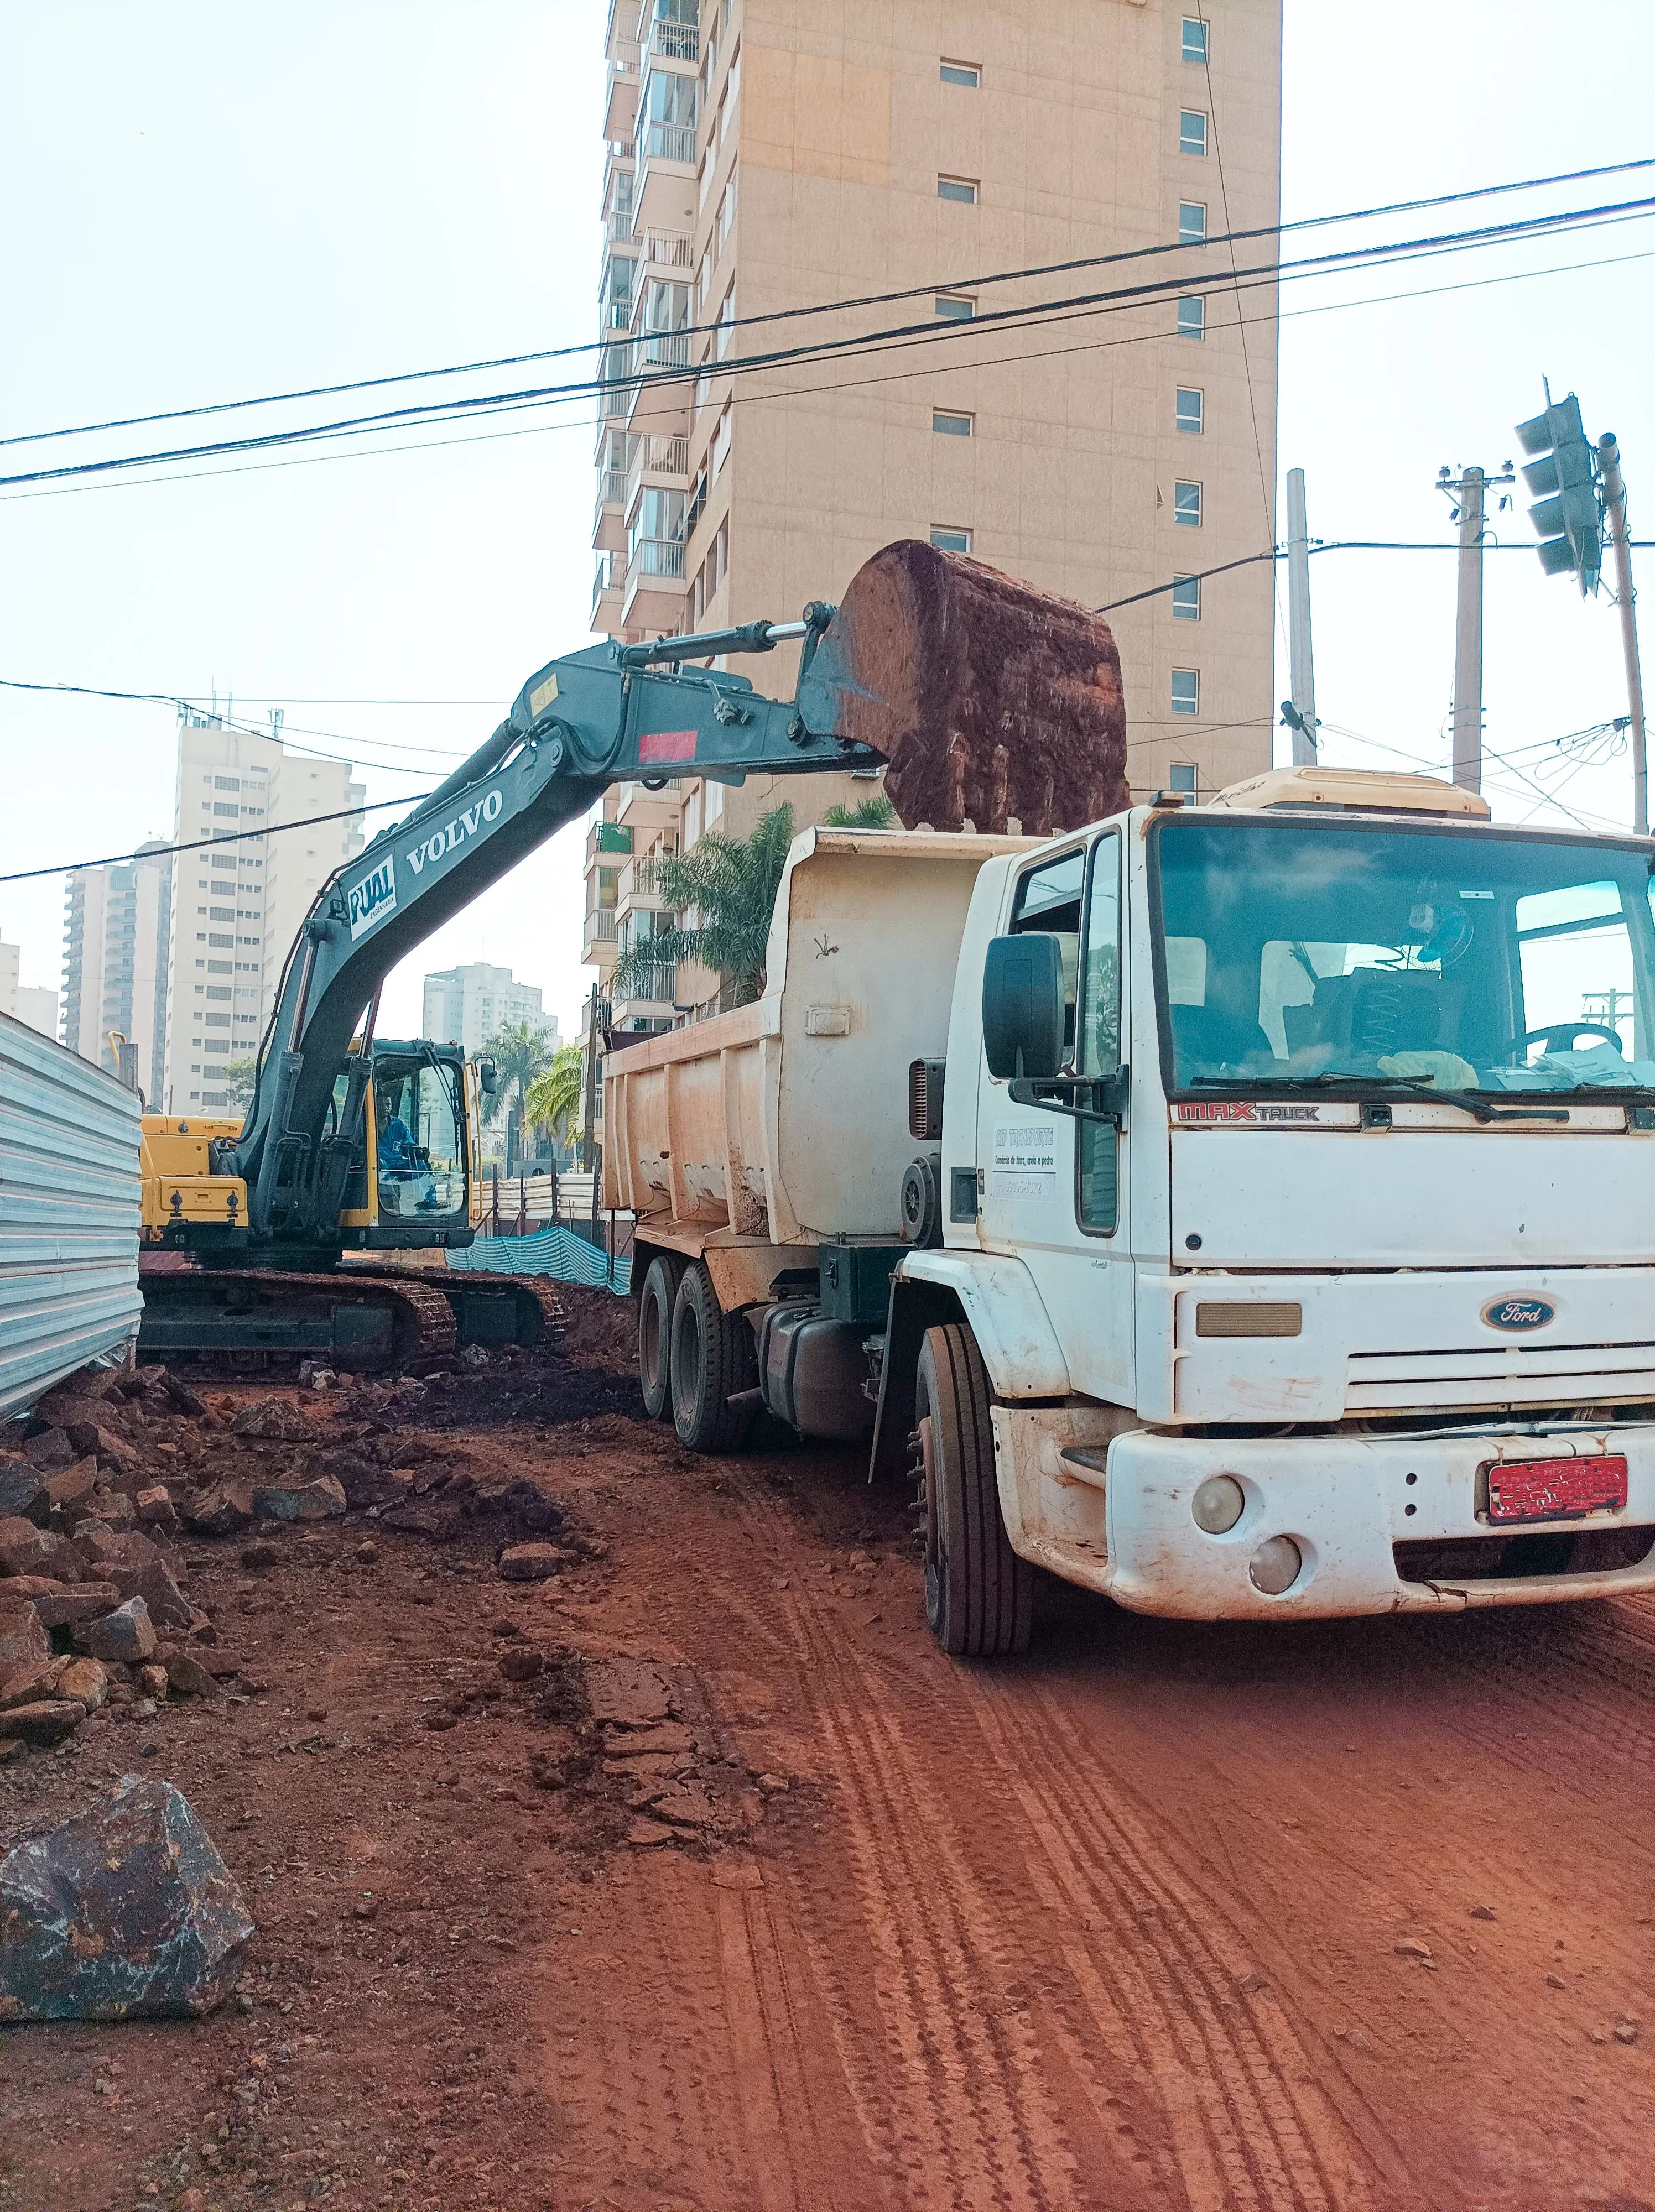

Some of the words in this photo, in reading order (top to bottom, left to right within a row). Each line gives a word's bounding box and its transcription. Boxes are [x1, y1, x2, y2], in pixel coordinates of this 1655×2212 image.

[407, 790, 503, 875] VOLVO
[370, 896, 394, 919] ENGENHARIA
[1179, 1102, 1256, 1121] MAX
[1256, 1106, 1319, 1121] TRUCK
[1009, 1127, 1054, 1147] TRANSPORTE
[1011, 1155, 1015, 1165] de
[1027, 1155, 1036, 1165] areia
[1042, 1155, 1053, 1167] pedra
[1501, 1302, 1542, 1322] Ford
